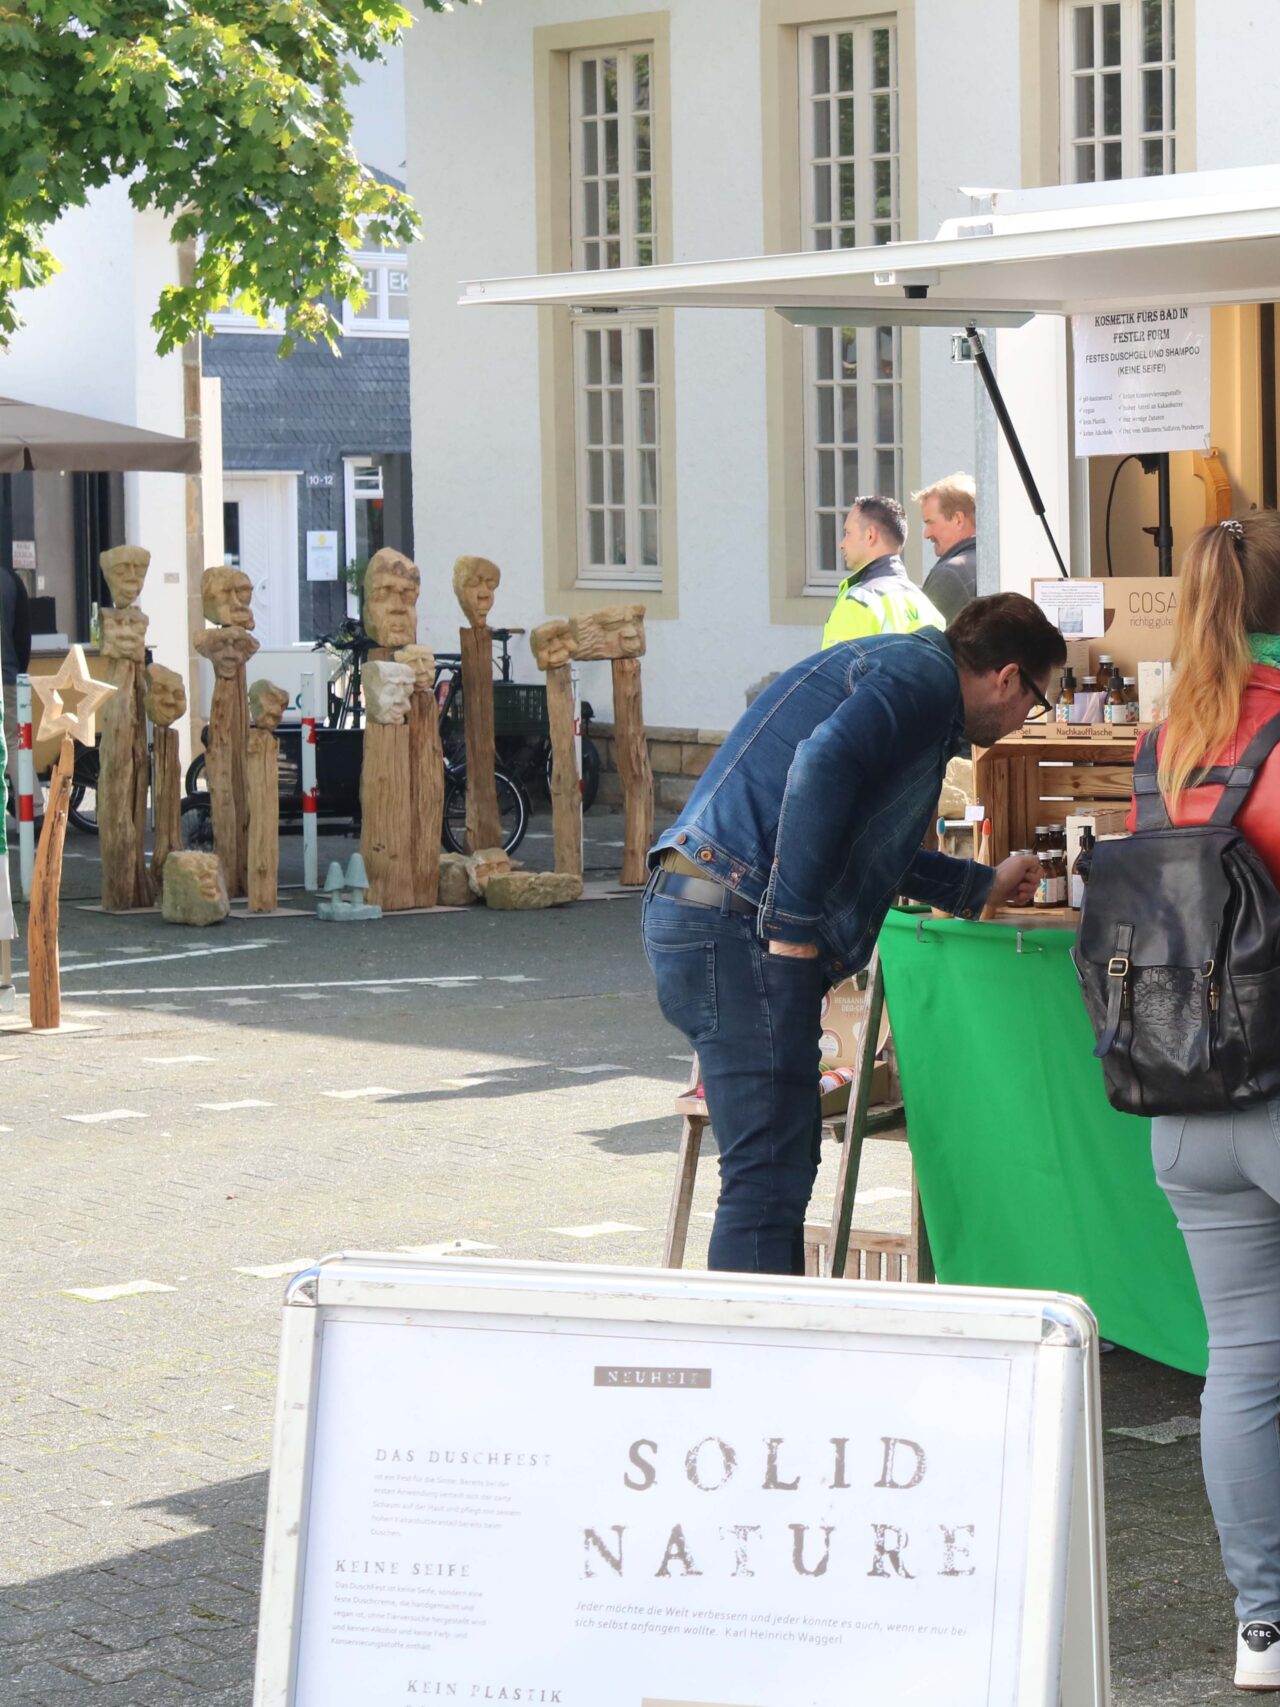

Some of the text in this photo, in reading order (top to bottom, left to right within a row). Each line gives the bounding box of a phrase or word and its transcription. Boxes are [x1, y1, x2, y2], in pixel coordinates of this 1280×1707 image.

[1095, 312, 1134, 327] KOSMETIK
[1160, 309, 1178, 320] BAD
[1180, 308, 1188, 318] IN
[1114, 329, 1170, 343] FESTER FORM
[1086, 346, 1200, 364] FESTES DUSCHGEL UND SHAMPOO
[1118, 365, 1140, 376] (KEINE
[309, 475, 333, 485] 10-12
[1128, 592, 1176, 614] COSA
[1056, 728, 1112, 736] Nachkaufflasche
[608, 1370, 698, 1384] NEUHEIT
[376, 1449, 552, 1466] DAS DUSCHFEST
[623, 1436, 928, 1491] SOLID
[578, 1524, 976, 1580] NATURE
[335, 1560, 470, 1577] KEINE SEIFE
[576, 1601, 966, 1637] Jeder möchte die Welt verbessern und jeder könnte es auch, wenn er nur bei
[575, 1618, 843, 1646] sich selbst anfangen wollte. Karl Heinrich Waggerl
[1248, 1630, 1271, 1638] ACBC
[406, 1680, 563, 1703] KEIN PLASTIK
